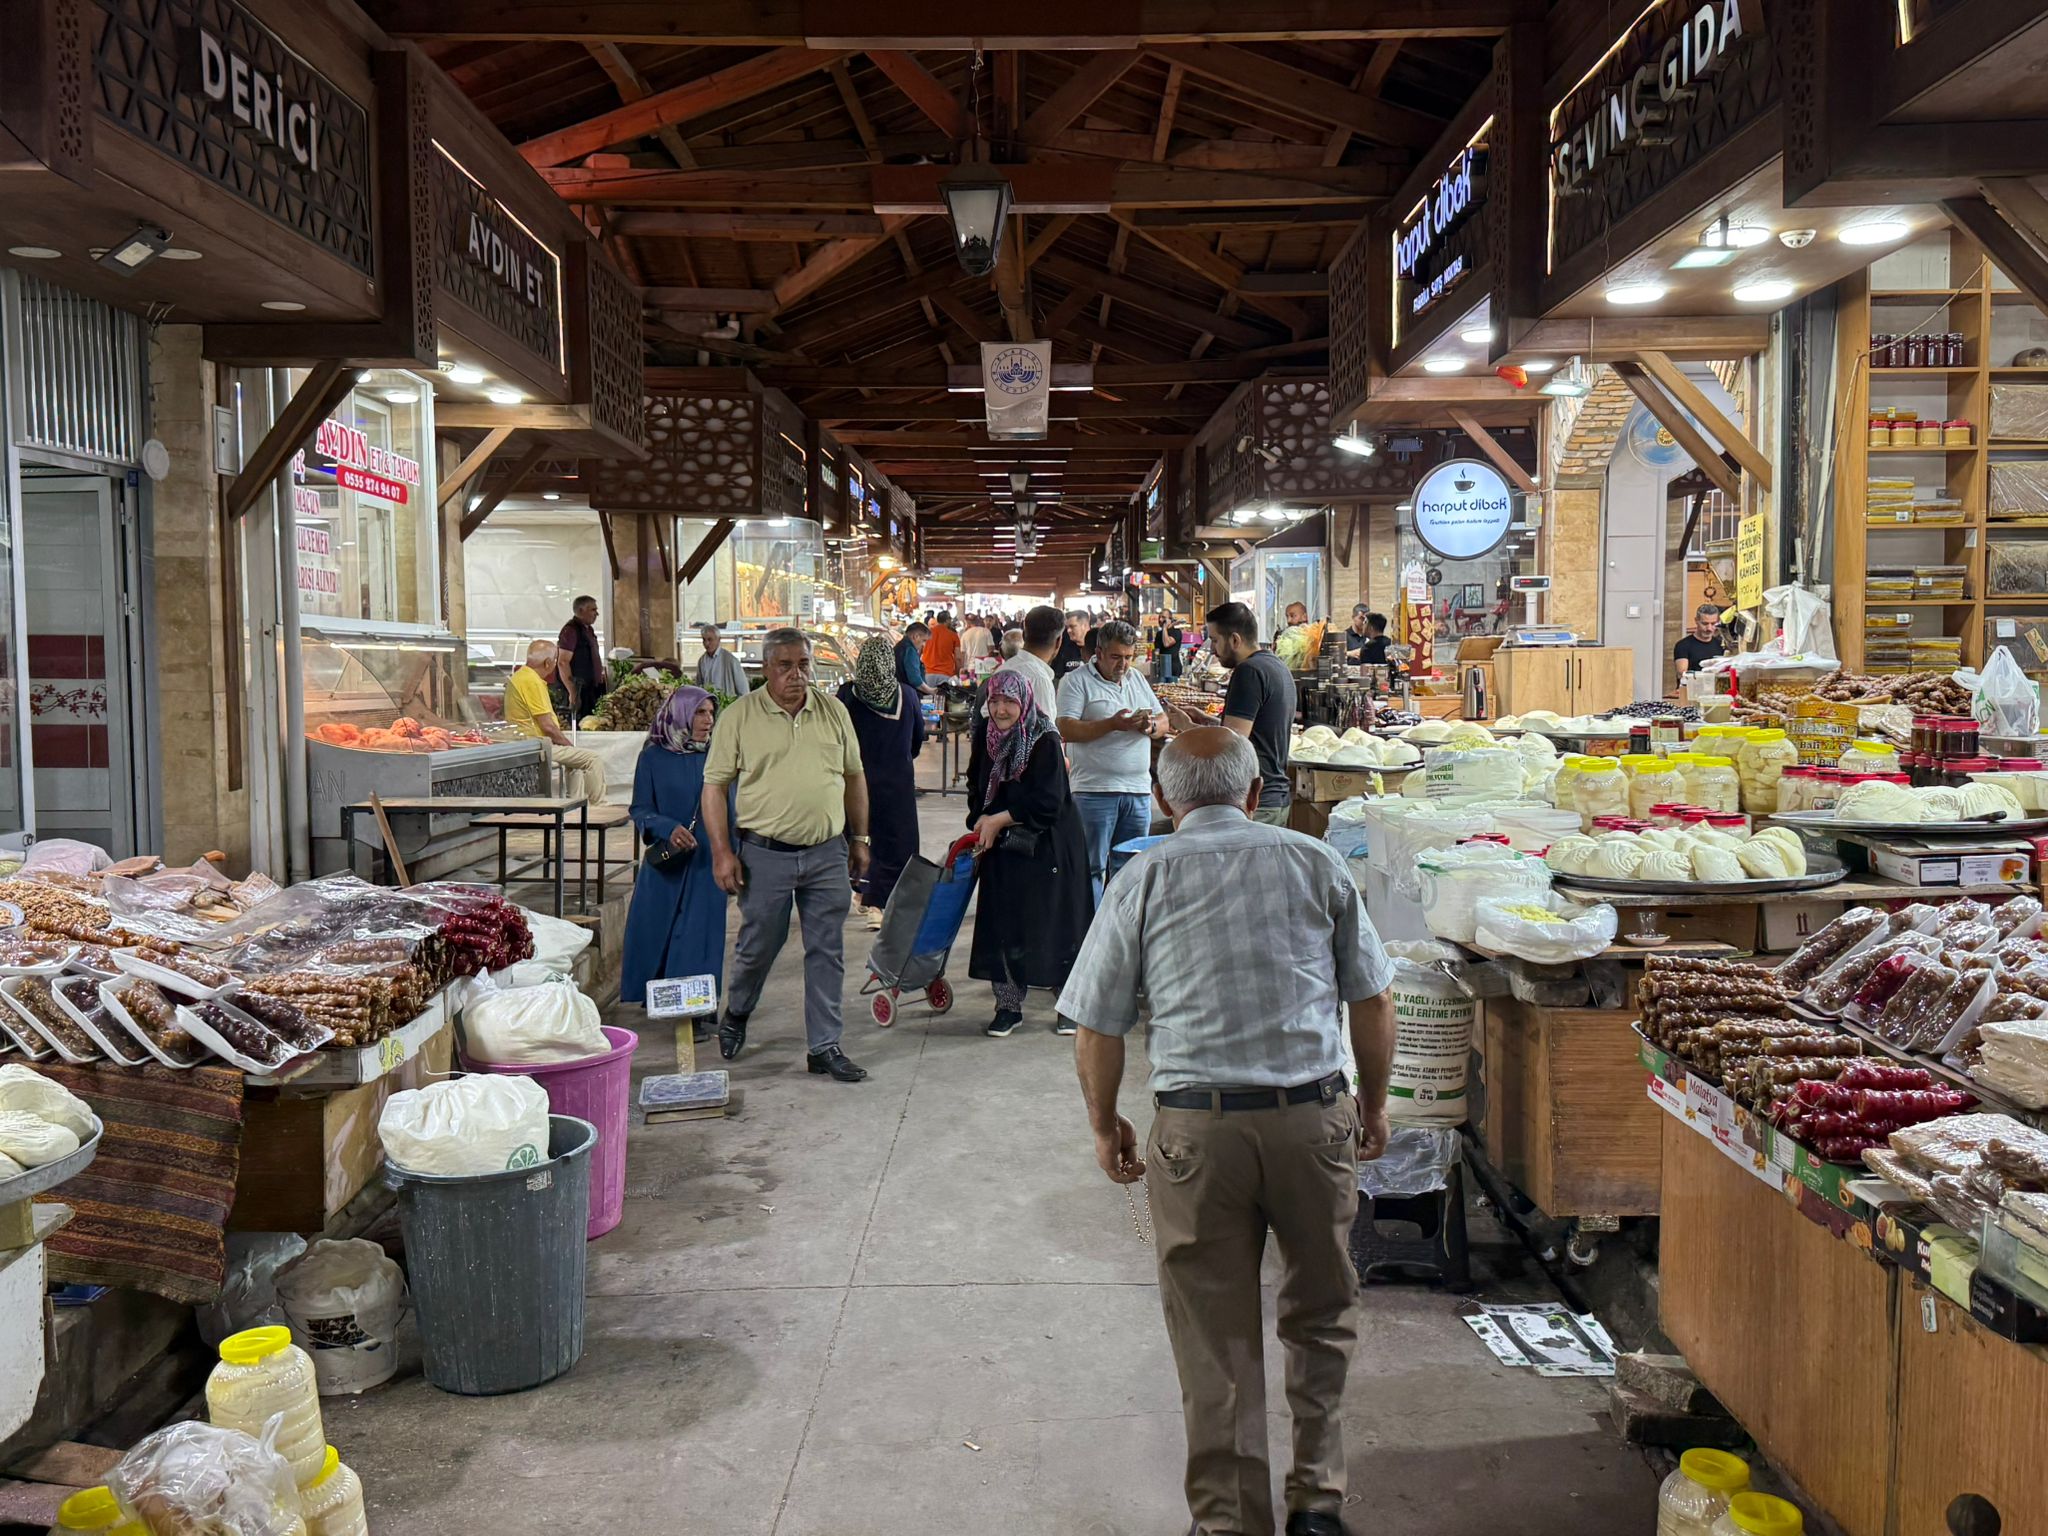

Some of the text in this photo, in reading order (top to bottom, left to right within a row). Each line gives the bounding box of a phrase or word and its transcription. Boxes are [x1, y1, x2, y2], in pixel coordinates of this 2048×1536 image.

[200, 29, 318, 173] DERİCİ
[1558, 0, 1743, 197] SEVİNÇ GIDA
[469, 211, 543, 309] AYDIN ET
[316, 418, 420, 486] AYDIN ET & TAVUK
[344, 471, 401, 500] 0535 274 94 07
[1422, 497, 1507, 515] harput dibek
[1744, 520, 1756, 535] TAZE
[1743, 549, 1756, 563] TÜRK
[1404, 993, 1429, 1006] YAĞLI
[1416, 1007, 1449, 1019] ERİTME
[1689, 1079, 1718, 1109] Malatya
